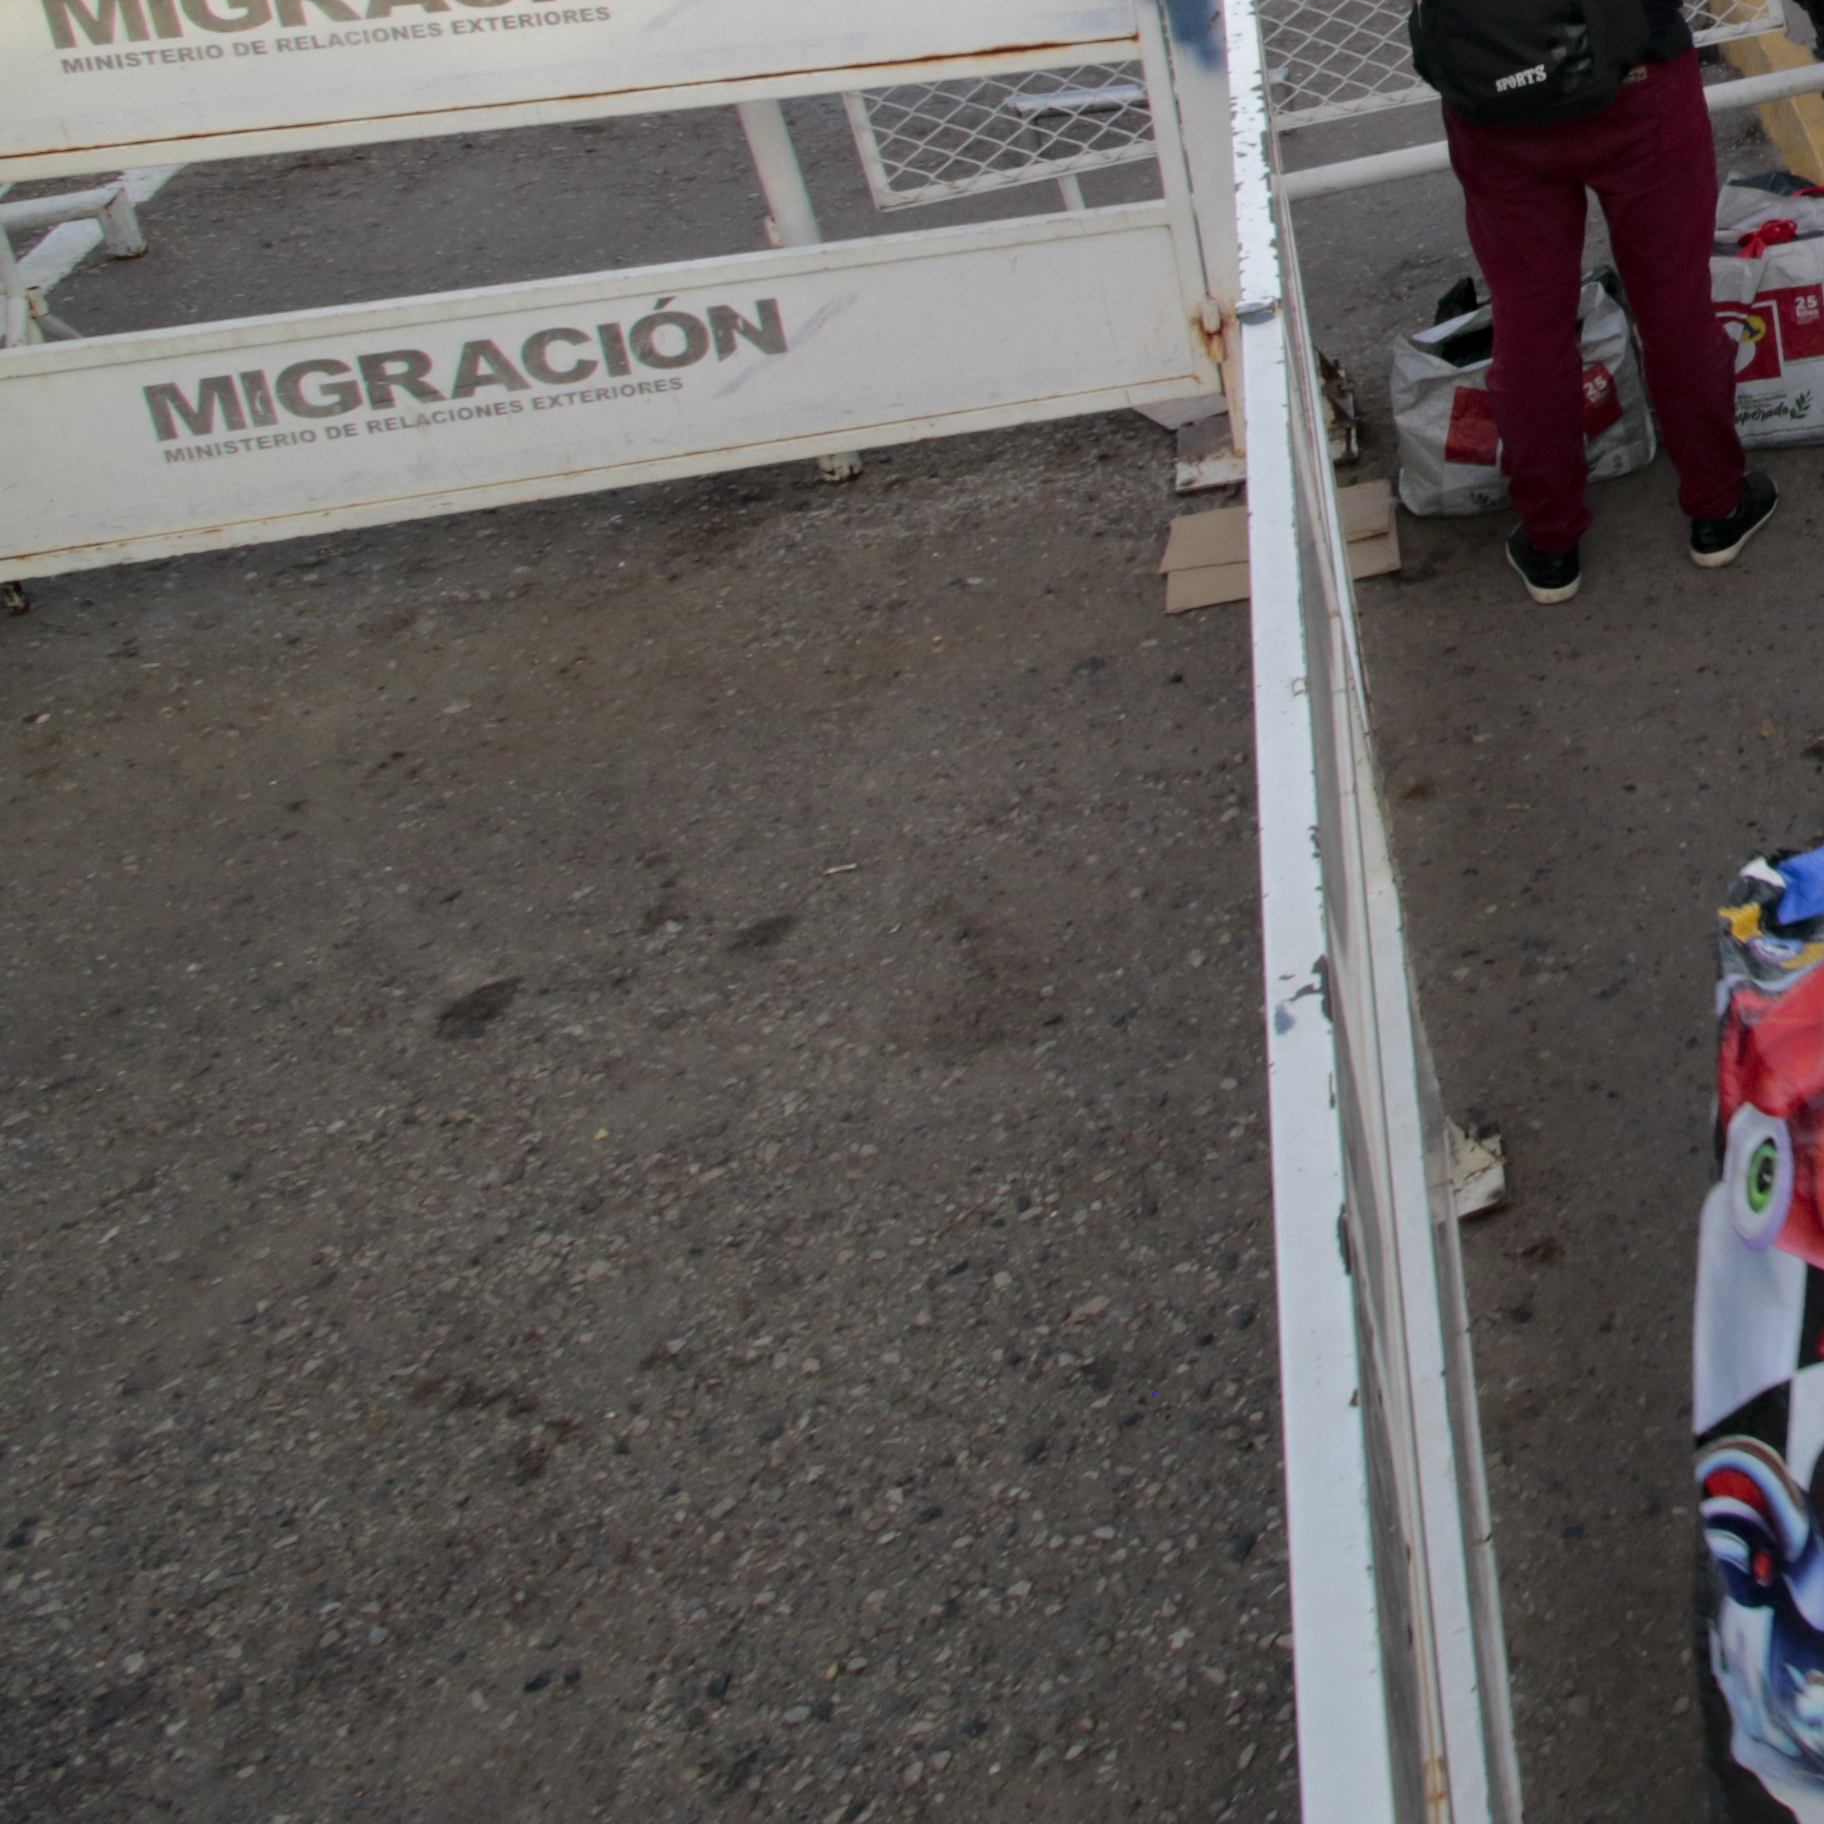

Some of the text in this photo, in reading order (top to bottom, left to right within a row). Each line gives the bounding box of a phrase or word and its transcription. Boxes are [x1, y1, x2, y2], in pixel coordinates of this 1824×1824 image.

[61, 7, 611, 75] MINISTERIO DE RELACIONES EXTERIORES
[1495, 64, 1547, 92] SPORTS
[1795, 294, 1818, 309] 25
[142, 296, 788, 441] MIGRACIÓN
[164, 377, 684, 463] MINISTERIO DE RELACIONES EXTERIORES
